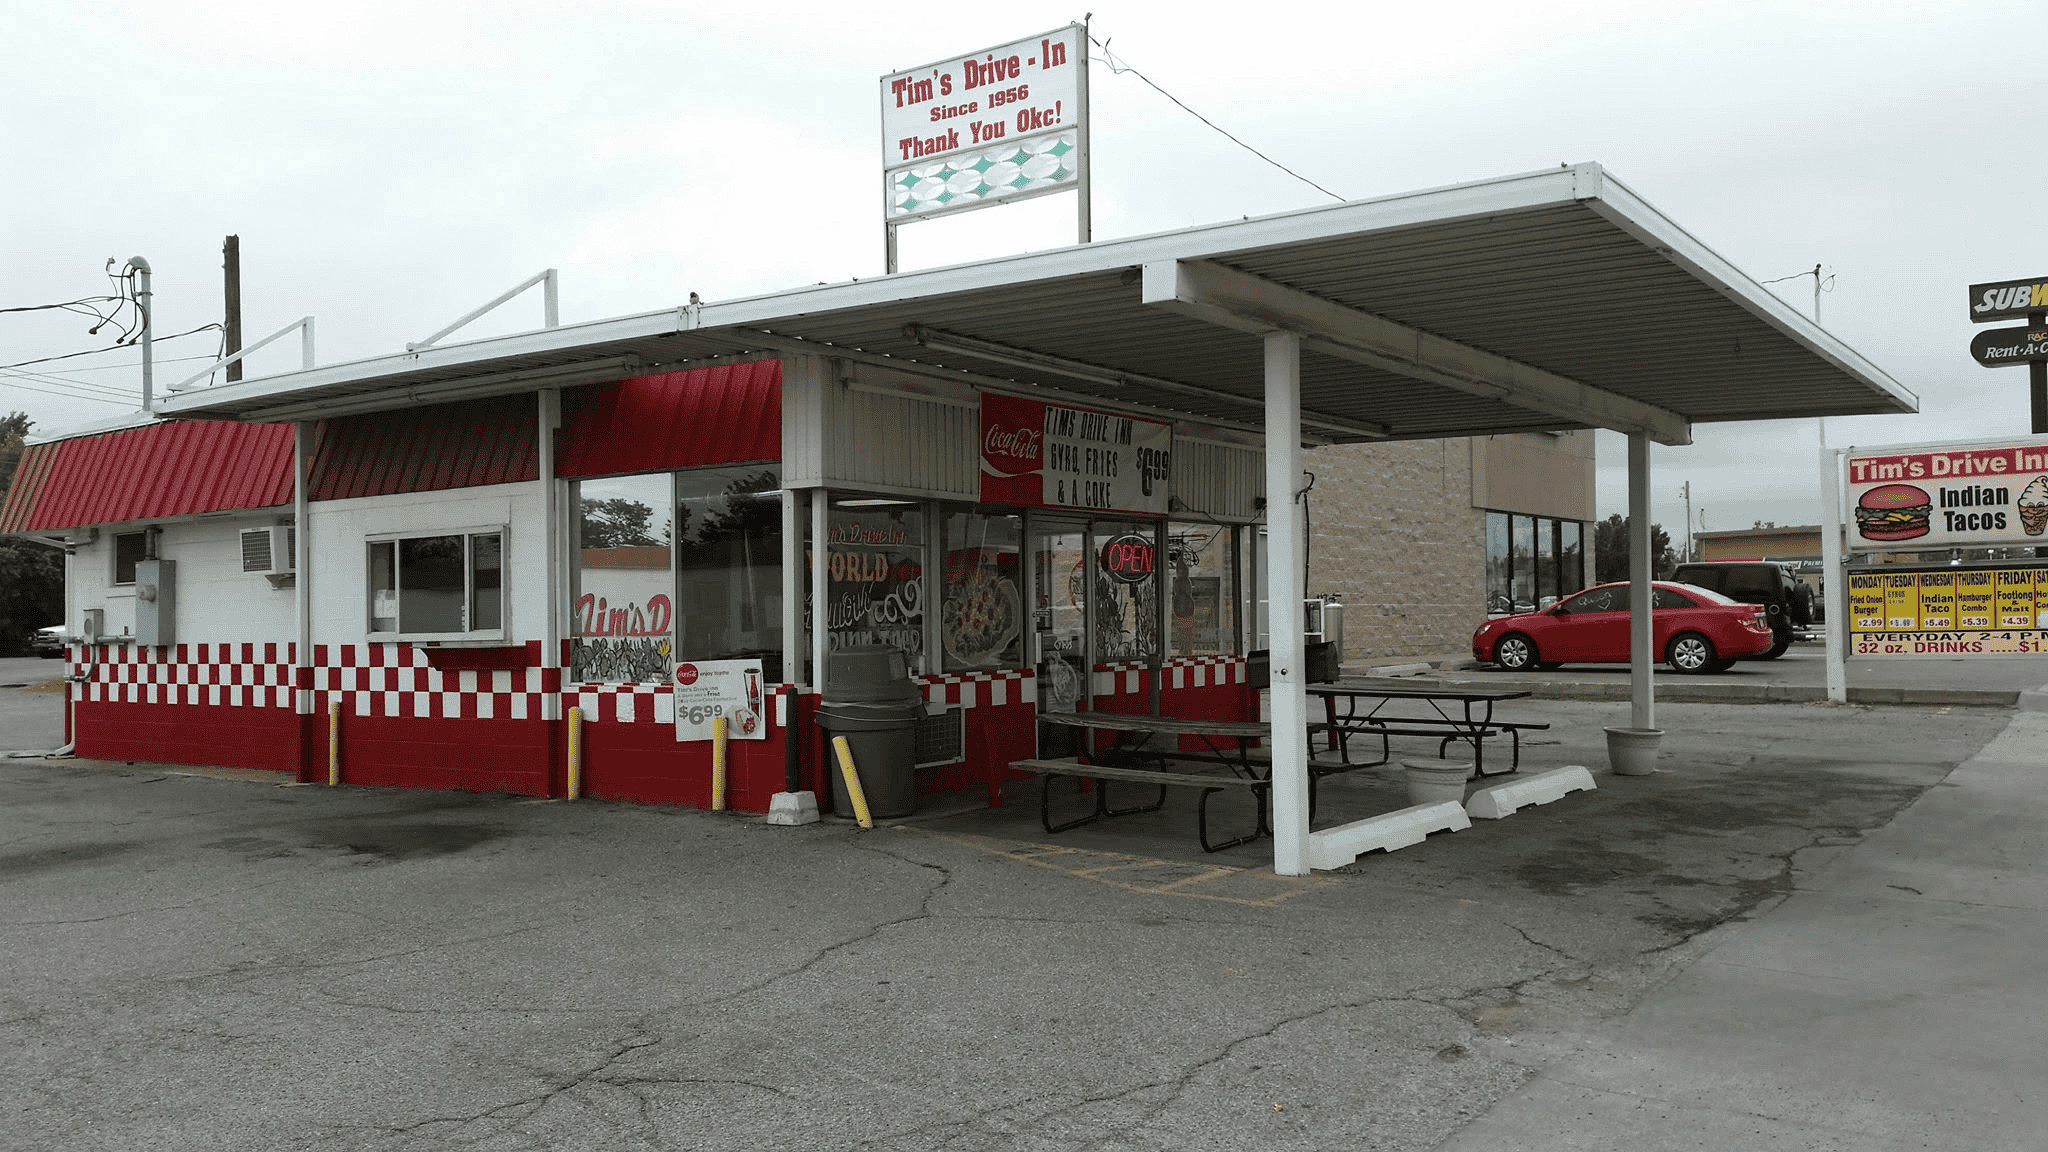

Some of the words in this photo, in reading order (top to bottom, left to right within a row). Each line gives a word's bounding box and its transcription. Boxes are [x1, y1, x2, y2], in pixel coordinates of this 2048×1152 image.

[892, 69, 952, 108] Tim's
[963, 54, 1020, 91] Drive
[1041, 39, 1067, 70] In
[930, 102, 978, 122] Since
[988, 84, 1029, 109] 1956
[899, 128, 959, 160] Thank
[970, 120, 1006, 144] You
[1016, 100, 1062, 133] Okc!
[1046, 407, 1076, 438] TIMS
[1080, 411, 1109, 442] DRIVE
[1115, 418, 1133, 446] INN
[985, 423, 1043, 460] Coca-Cola
[1050, 443, 1080, 476] GYRO,
[1085, 447, 1118, 478] FRIES
[1851, 457, 1926, 481] Tim's
[1931, 453, 2008, 477] Drive
[2015, 449, 2048, 471] In
[1057, 479, 1065, 504] &
[1071, 479, 1079, 506] A
[1085, 480, 1112, 509] COKE
[1939, 485, 2009, 508] Indian
[1943, 510, 2007, 532] Tacos
[1109, 543, 1153, 574] OPEN
[1851, 575, 1883, 589] MONDAY
[1886, 574, 1916, 588] TUESDAY
[1920, 572, 1954, 587] WEDNESDAY
[1957, 571, 1991, 586] THURSDAY
[1997, 570, 2032, 585] FRIDAY
[1850, 595, 1864, 604] Fried
[1866, 595, 1883, 604] Onion
[1921, 593, 1954, 603] Indian
[1958, 593, 1992, 603] Hamburger
[2036, 590, 2048, 598] Ho
[575, 593, 646, 637] Tim's
[1854, 605, 1878, 616] Burger
[1924, 603, 1950, 613] Taco
[1961, 604, 1987, 612] Combo
[1858, 618, 1883, 627] $2.99
[1925, 618, 1950, 627] $5.49
[1962, 618, 1988, 626] $5.39
[2002, 617, 2029, 625] $4.39
[1863, 632, 1966, 642] EVERYDAY
[1980, 631, 2012, 641] 2-4
[1858, 642, 1878, 653] 32
[1885, 643, 1908, 654] oz.
[1915, 641, 1983, 654] DRINKS
